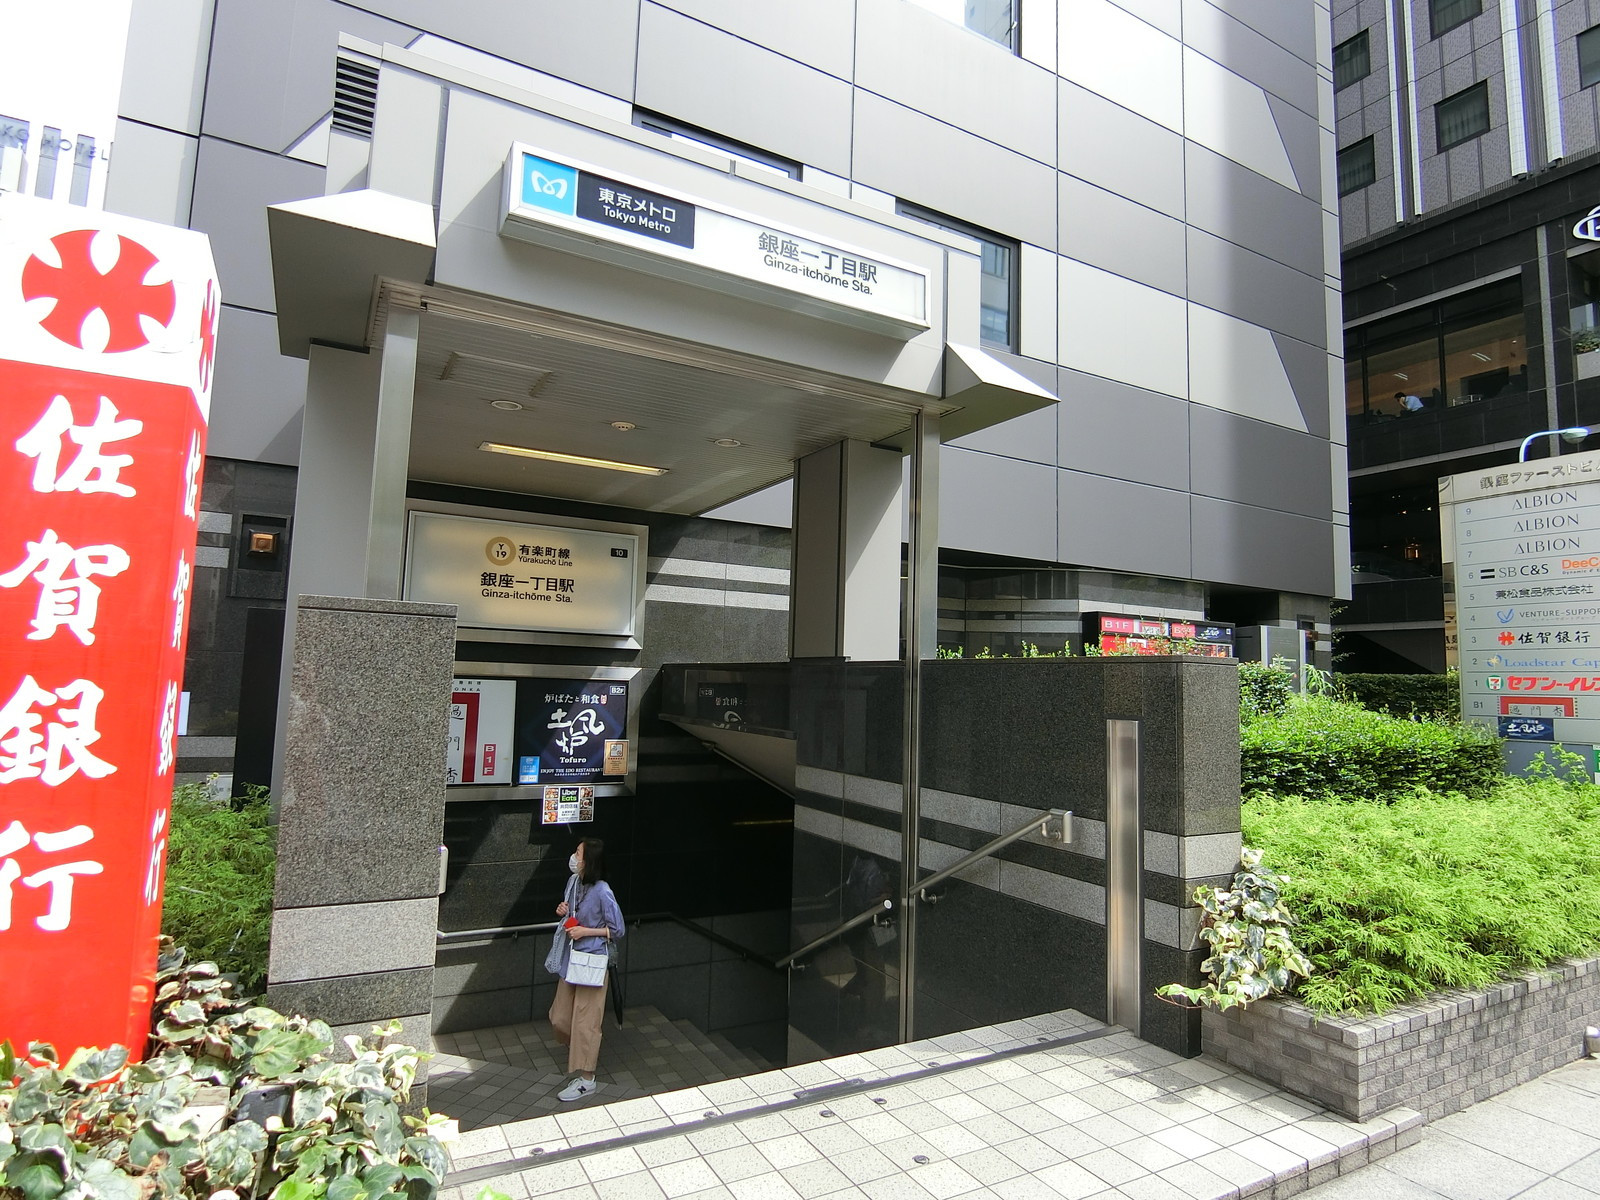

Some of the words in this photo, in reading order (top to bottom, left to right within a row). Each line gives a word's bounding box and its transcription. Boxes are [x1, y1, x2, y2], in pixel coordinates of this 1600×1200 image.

[598, 187, 676, 223] 東京メトロ
[602, 205, 636, 224] Tokyo
[638, 215, 671, 234] Metro
[758, 231, 878, 284] 銀座一丁目駅
[763, 254, 849, 289] Ginza-itchōme
[851, 279, 873, 296] Sta.
[1480, 459, 1600, 490] 銀座ファーストビ
[1512, 490, 1578, 511] ALBION
[1513, 513, 1579, 533] ALBION
[518, 544, 571, 559] 有楽町線
[614, 549, 624, 557] 10
[1514, 537, 1580, 555] ALBION
[495, 549, 507, 559] 19
[518, 555, 557, 566] Yūrakuchō
[558, 558, 573, 567] Line
[1499, 566, 1517, 578] SB
[1520, 563, 1549, 576] C&S
[1561, 556, 1600, 570] DeeC
[480, 571, 575, 593] 銀座一丁目駅
[481, 588, 552, 602] Ginza-itchōme
[555, 593, 573, 603] Sta.
[1104, 620, 1129, 630] B1F
[1471, 636, 1477, 644] 3
[1517, 630, 1591, 645] 佐賀銀行
[0, 394, 144, 932] 佐賀銀行
[143, 429, 202, 907] 佐賀銀行
[1472, 657, 1478, 665] 2
[1504, 658, 1566, 667] Loadstar
[611, 686, 624, 694] B2F
[1474, 679, 1478, 687] 1
[1473, 701, 1483, 709] B1
[483, 745, 496, 775] B1F
[559, 756, 587, 764] Tofuro
